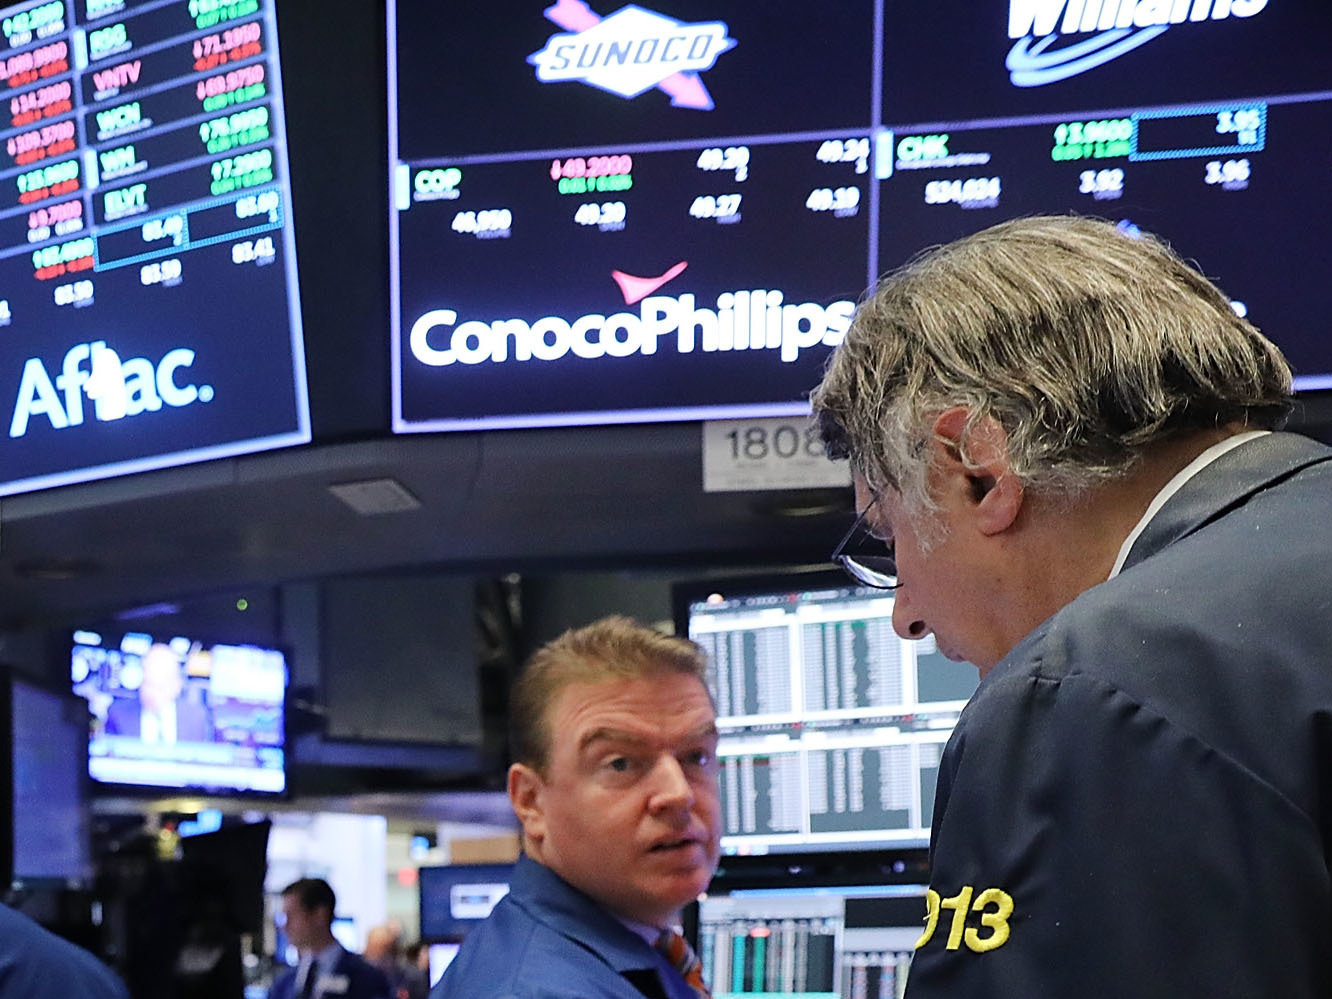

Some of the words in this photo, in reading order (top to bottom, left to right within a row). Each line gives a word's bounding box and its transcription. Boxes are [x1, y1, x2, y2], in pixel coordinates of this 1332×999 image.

[549, 34, 714, 71] SUNOCO
[415, 168, 462, 193] COP
[409, 290, 855, 367] ConocoPhillips
